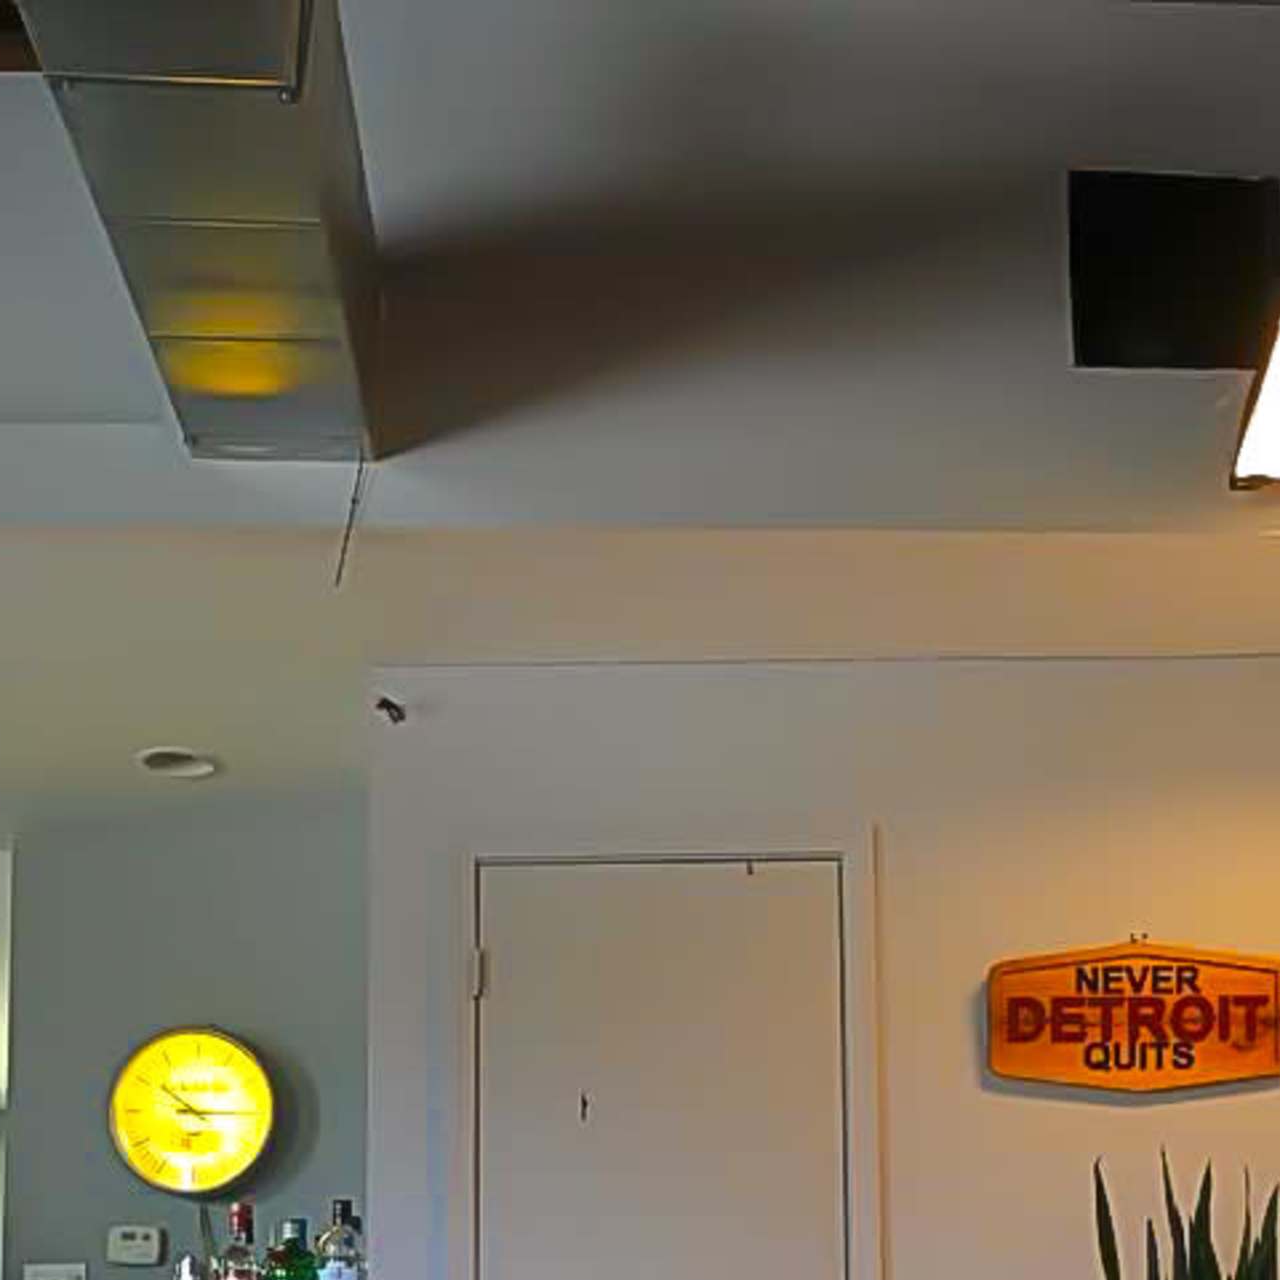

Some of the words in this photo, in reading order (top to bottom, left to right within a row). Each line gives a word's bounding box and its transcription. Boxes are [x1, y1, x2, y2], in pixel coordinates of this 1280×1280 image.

[1075, 964, 1201, 995] NEVER
[1005, 995, 1270, 1044] DETROIT
[1083, 1041, 1195, 1071] QUITS
